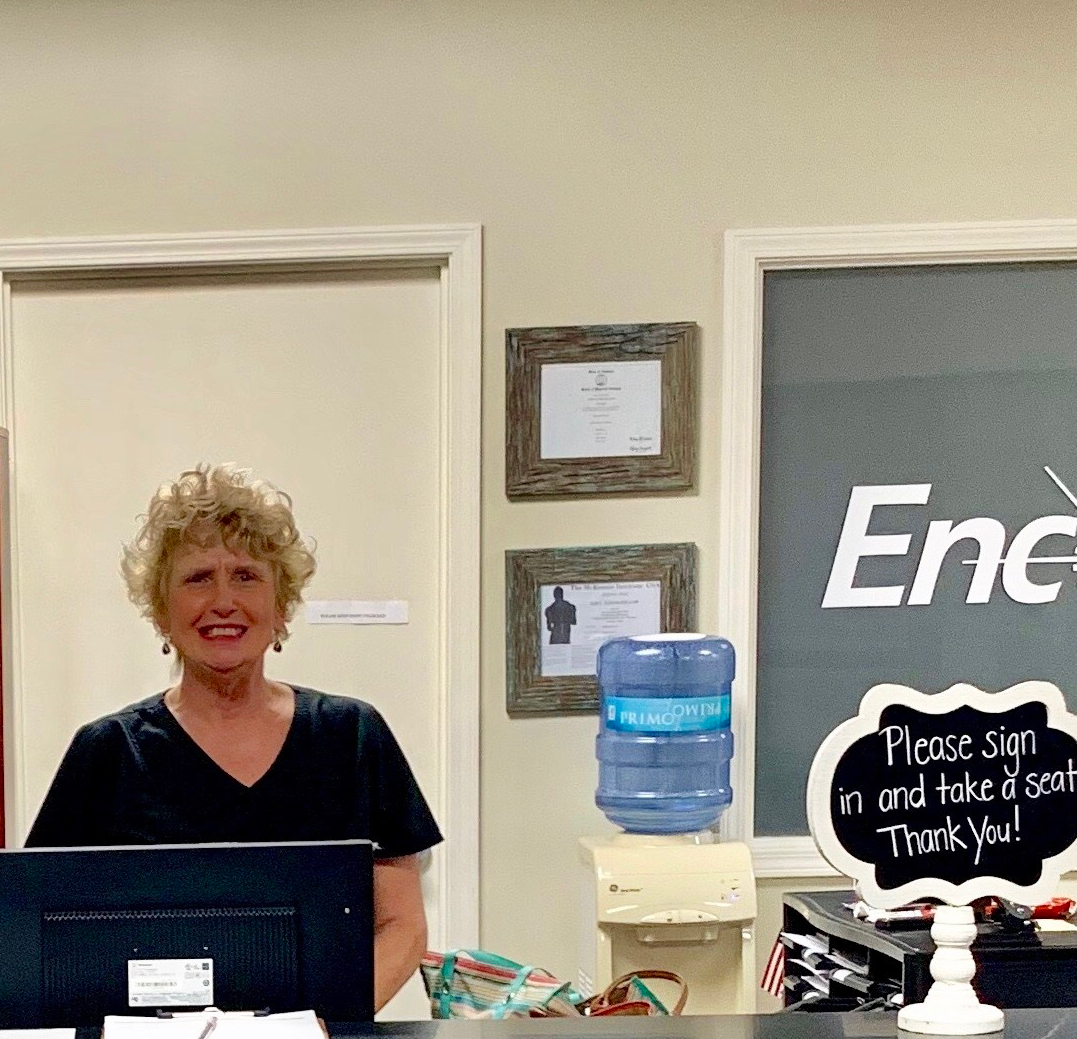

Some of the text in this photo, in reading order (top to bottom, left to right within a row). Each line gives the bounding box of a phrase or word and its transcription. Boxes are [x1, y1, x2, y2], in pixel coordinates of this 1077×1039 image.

[821, 483, 1077, 608] Enc
[620, 711, 674, 725] PRIMO
[878, 725, 1036, 777] Please sign
[838, 758, 1077, 815] in and take a seat
[876, 805, 1021, 865] Thank You!
